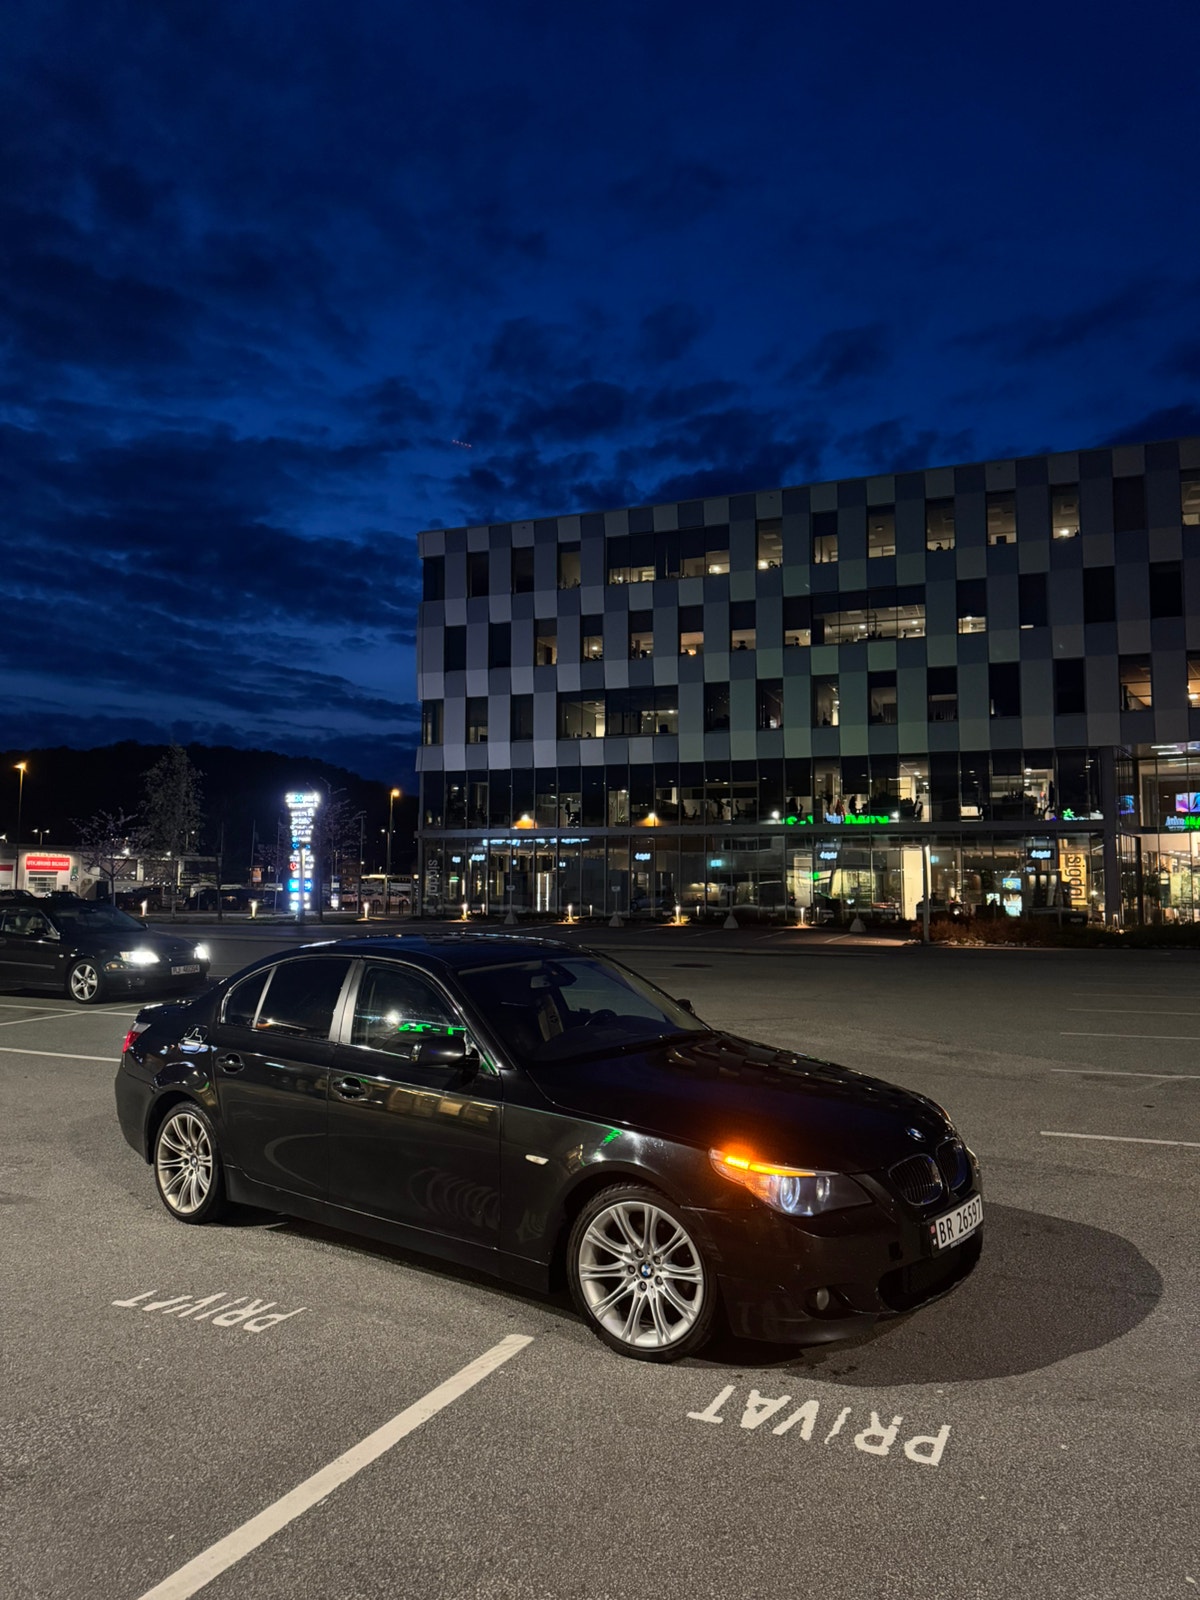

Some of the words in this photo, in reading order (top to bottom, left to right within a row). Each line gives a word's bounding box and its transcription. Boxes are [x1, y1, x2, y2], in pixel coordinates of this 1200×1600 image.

[1065, 856, 1086, 901] sigdal
[938, 1217, 955, 1245] BR
[956, 1198, 981, 1234] 26597
[111, 1289, 308, 1333] PRIVAT
[686, 1384, 952, 1467] PRIVAT
